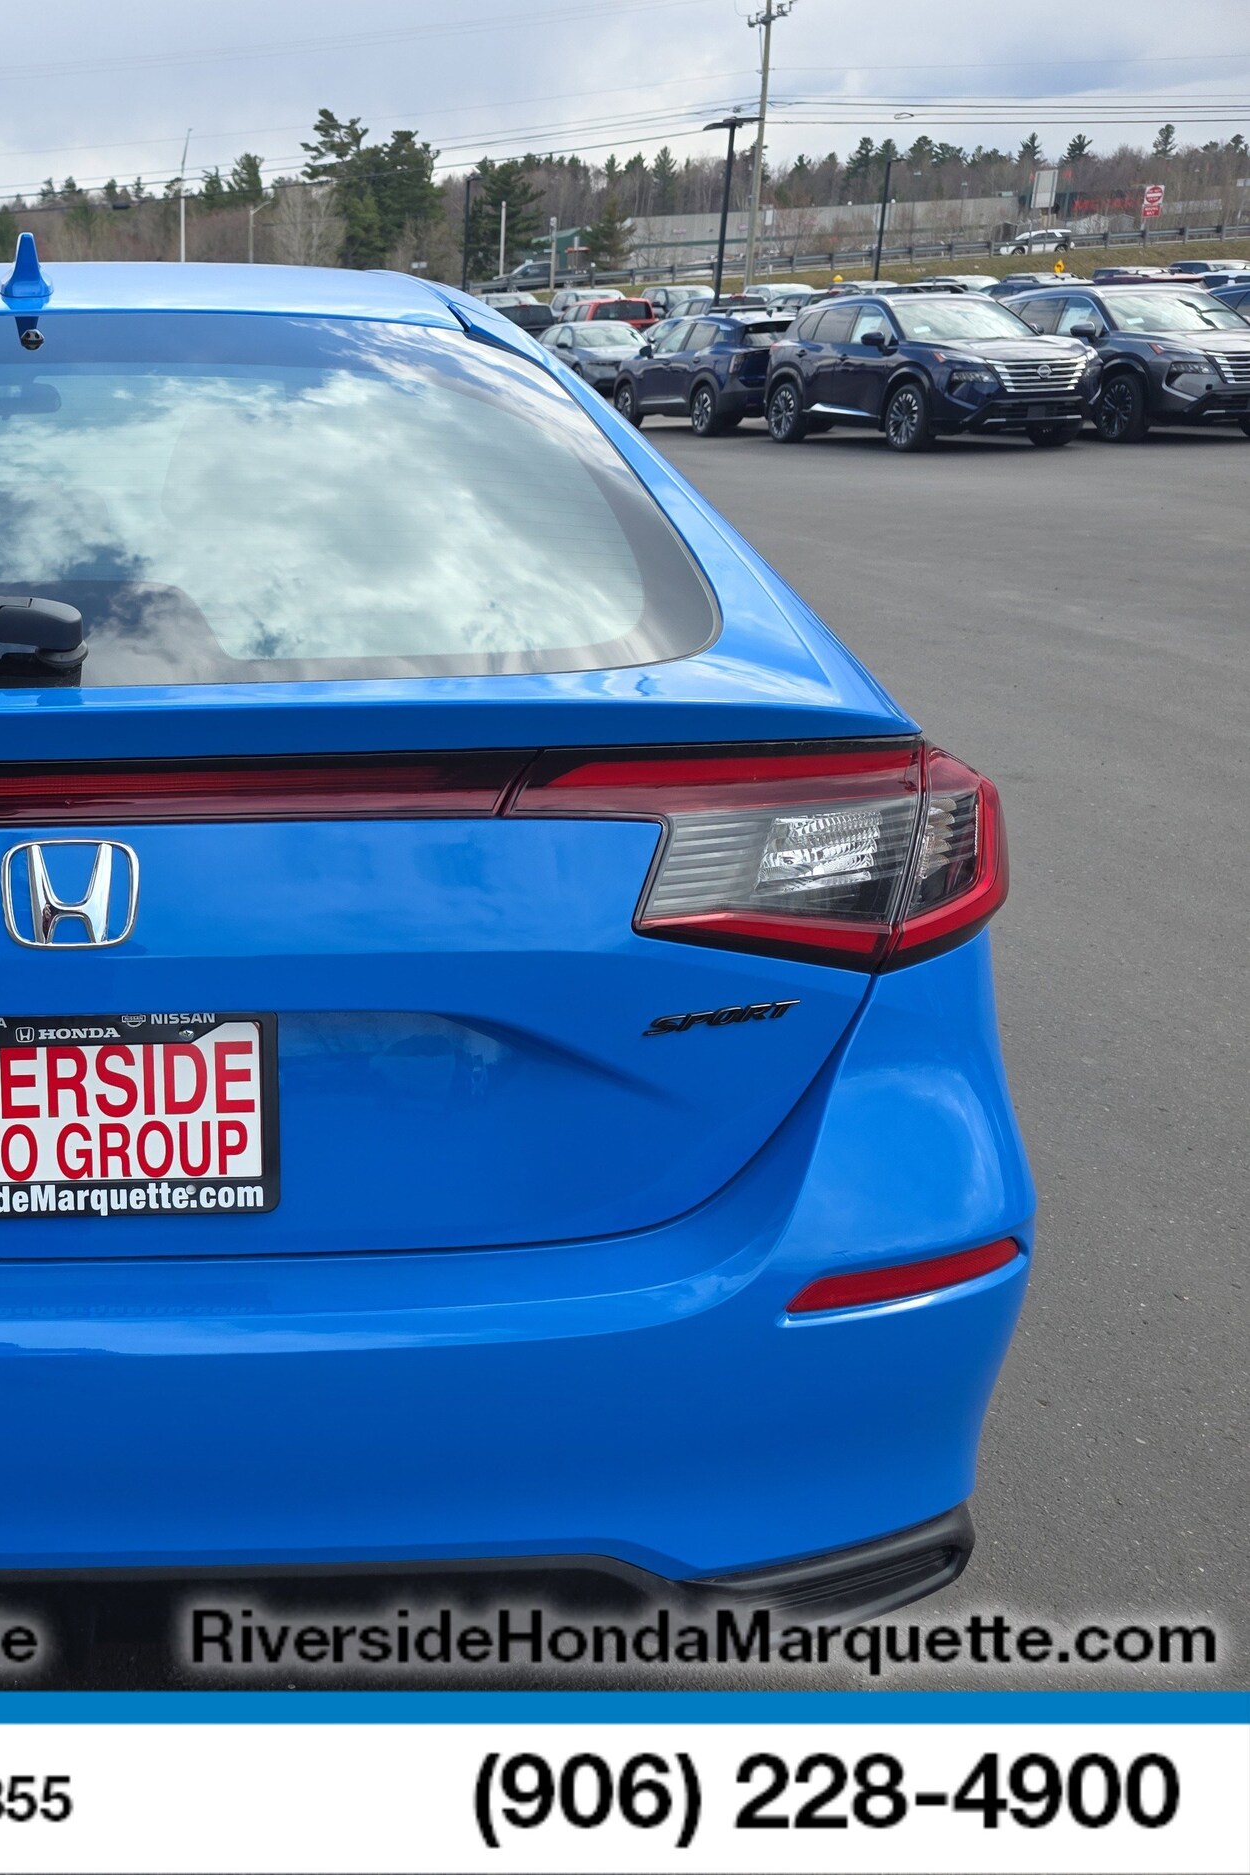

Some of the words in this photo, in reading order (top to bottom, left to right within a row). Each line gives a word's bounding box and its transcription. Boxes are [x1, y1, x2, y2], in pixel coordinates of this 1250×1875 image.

[150, 1013, 216, 1025] NISSAN
[642, 999, 801, 1036] SPORT
[38, 1027, 121, 1040] HONDA
[56, 1120, 249, 1180] GROUP
